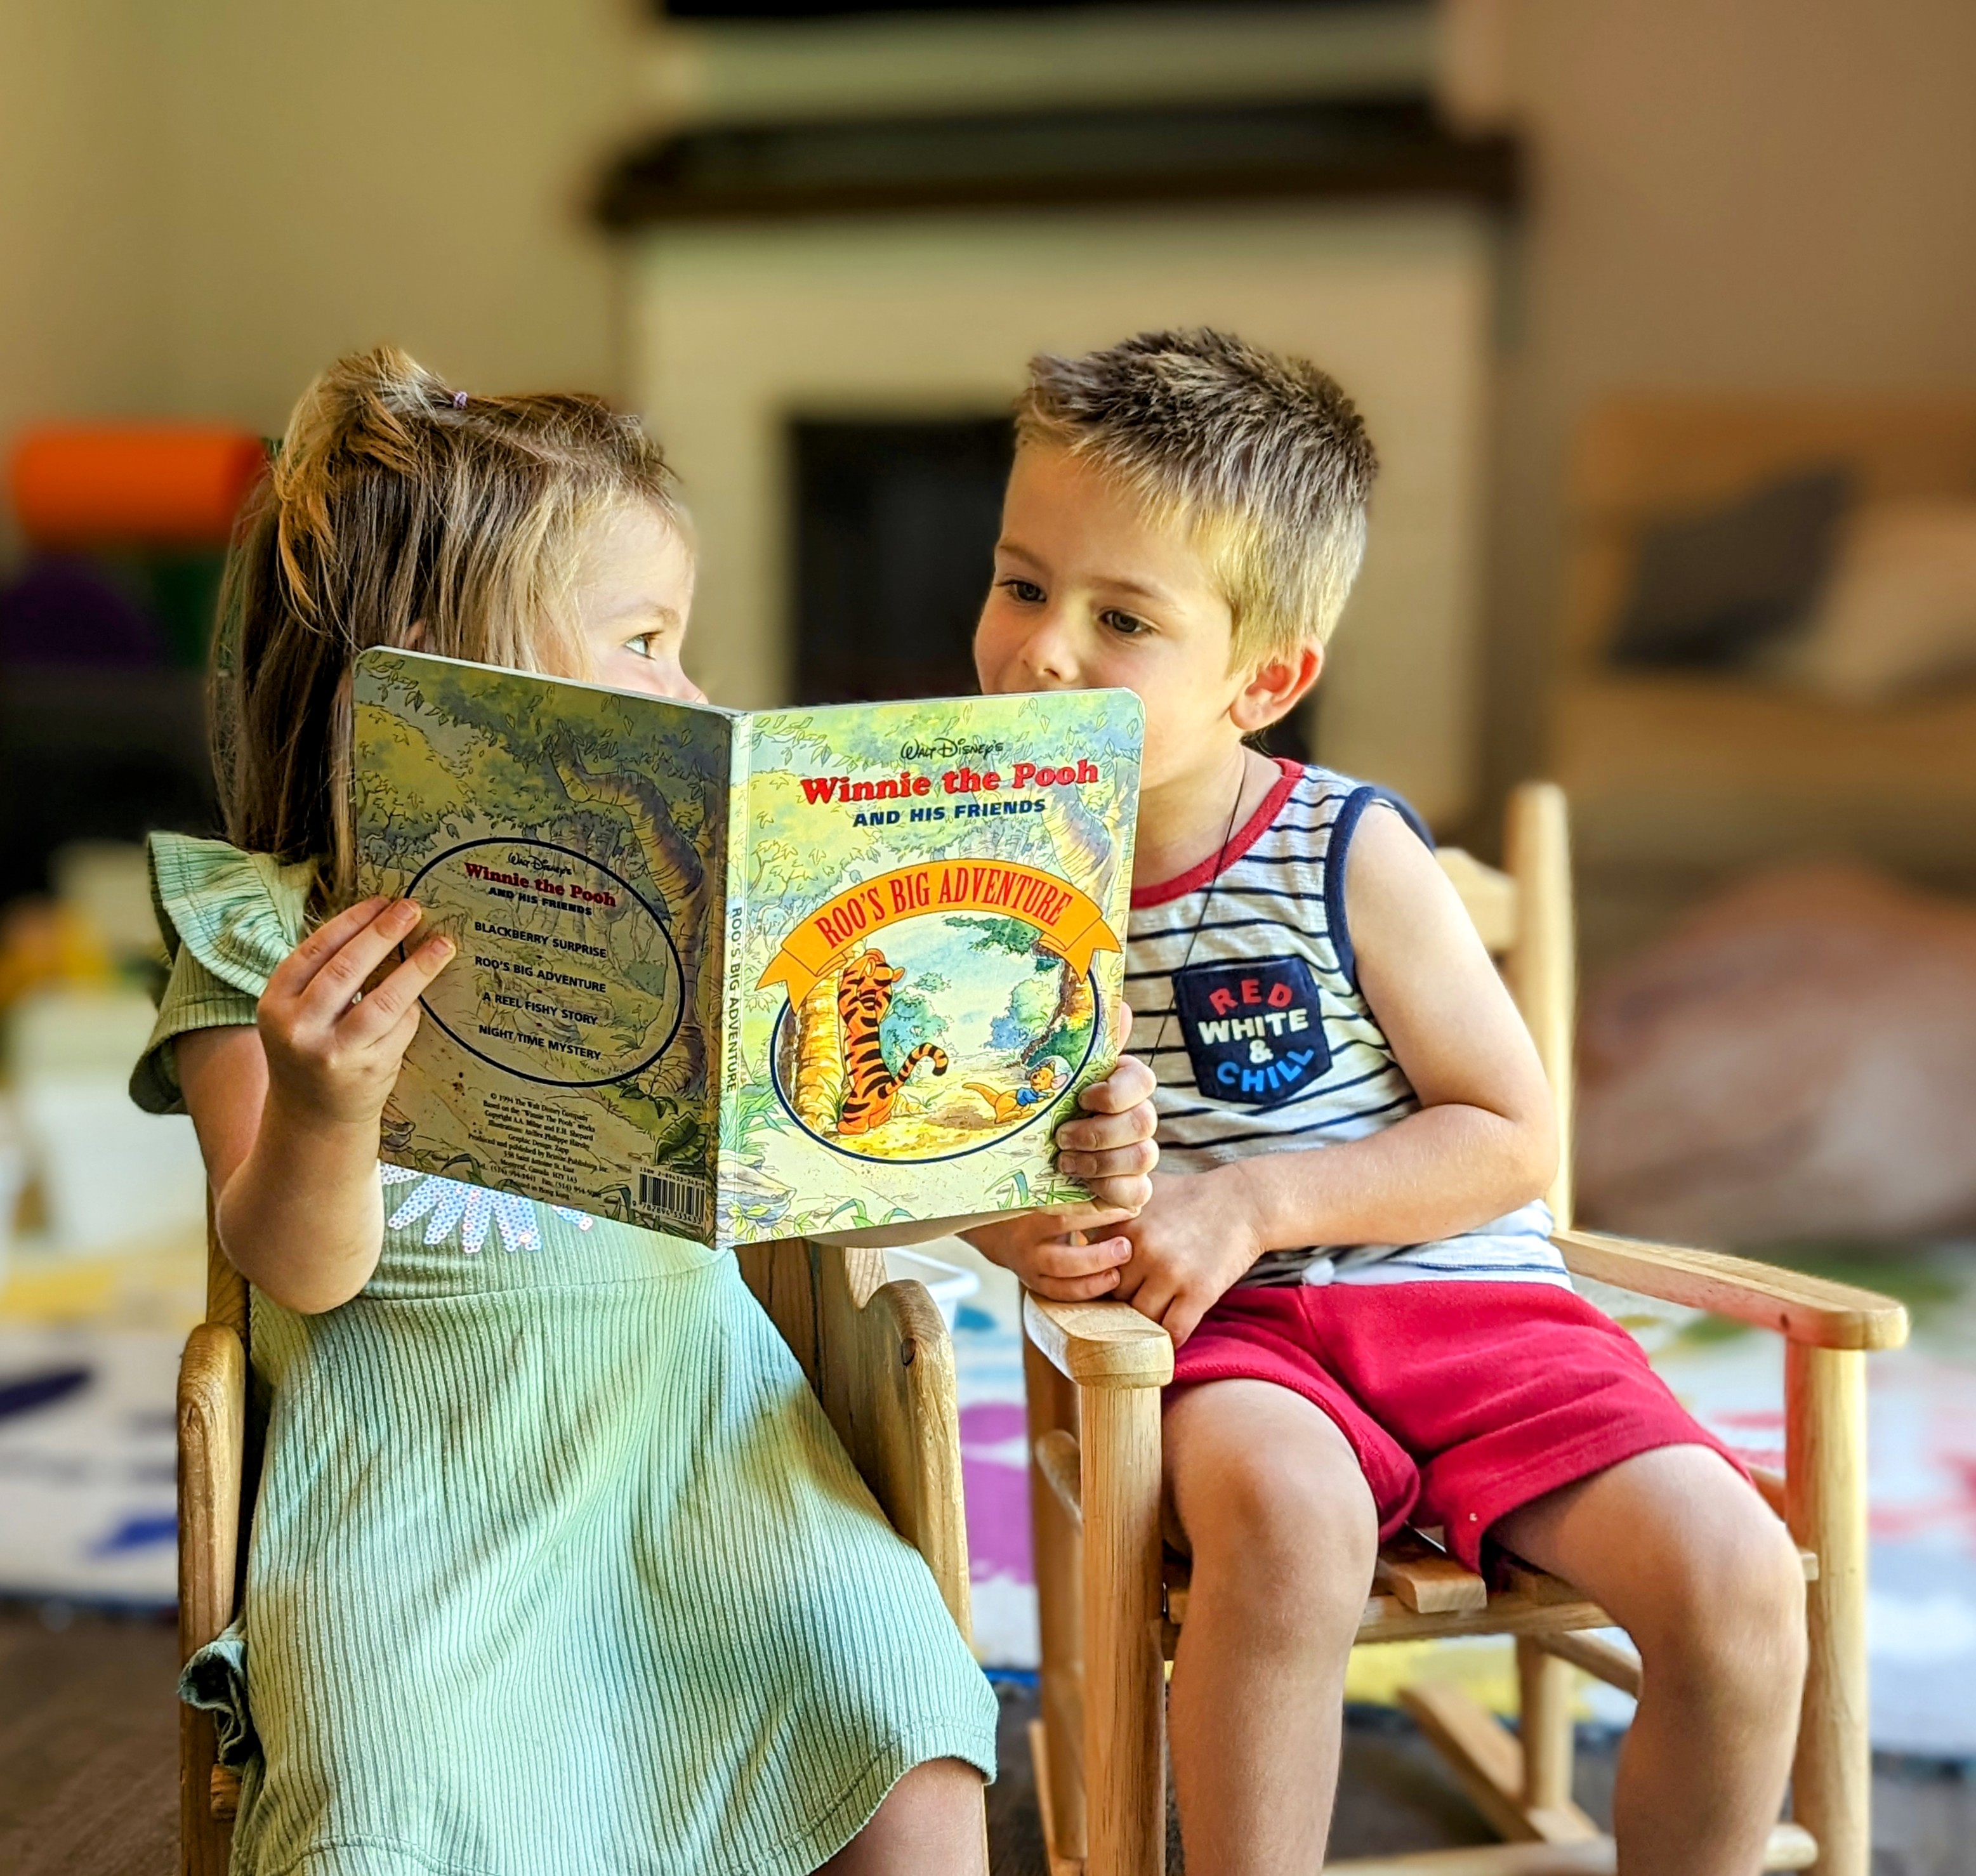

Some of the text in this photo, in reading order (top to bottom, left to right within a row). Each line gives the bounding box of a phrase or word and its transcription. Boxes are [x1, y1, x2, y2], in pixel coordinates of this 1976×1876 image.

[800, 759, 1099, 804] Winnie the Pooh
[852, 799, 1046, 827] AND HIS FRIENDS
[464, 862, 616, 907] Winnie the Pooh
[489, 887, 592, 915] AND HIS FRIENDS
[813, 867, 1073, 949] ROO'S BIG ADVENTURE
[475, 921, 607, 958] BLACKBERRY SURPRISE
[475, 955, 606, 994] ROO'S BIG ADVENTURE
[482, 992, 598, 1025] A REEL FISHY STORY
[726, 907, 743, 1093] ROO'S BIG ADVENTURE
[1209, 978, 1293, 1015] RED
[479, 1025, 602, 1060] NIGHT TIME MYSTERY
[1198, 1008, 1308, 1045] WHITE
[1249, 1039, 1274, 1063] &
[1217, 1049, 1314, 1092] CHILL
[515, 1098, 526, 1106] The
